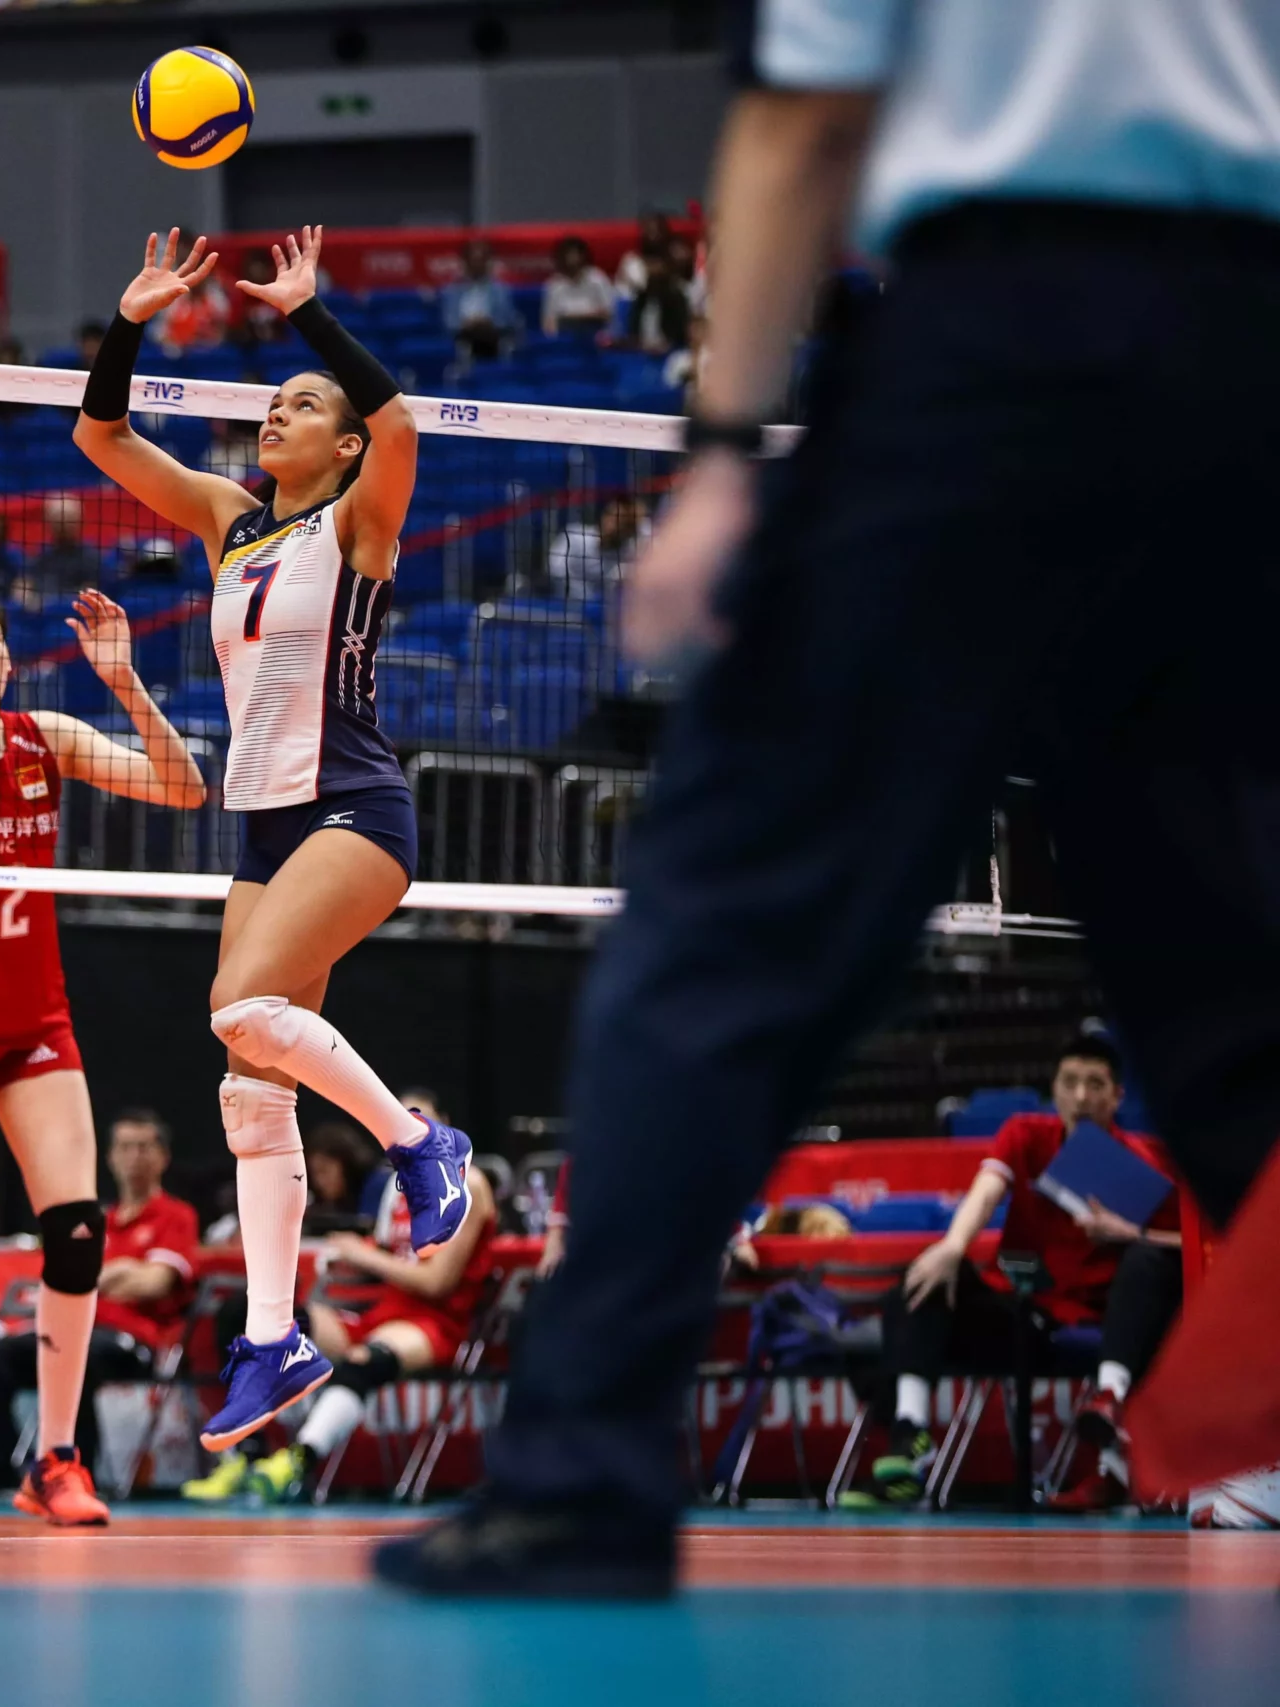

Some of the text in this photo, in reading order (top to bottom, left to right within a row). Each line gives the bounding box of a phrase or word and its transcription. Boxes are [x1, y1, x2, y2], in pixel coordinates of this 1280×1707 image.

[144, 381, 185, 400] FIVB
[440, 403, 479, 422] FIVB
[239, 559, 282, 643] 7
